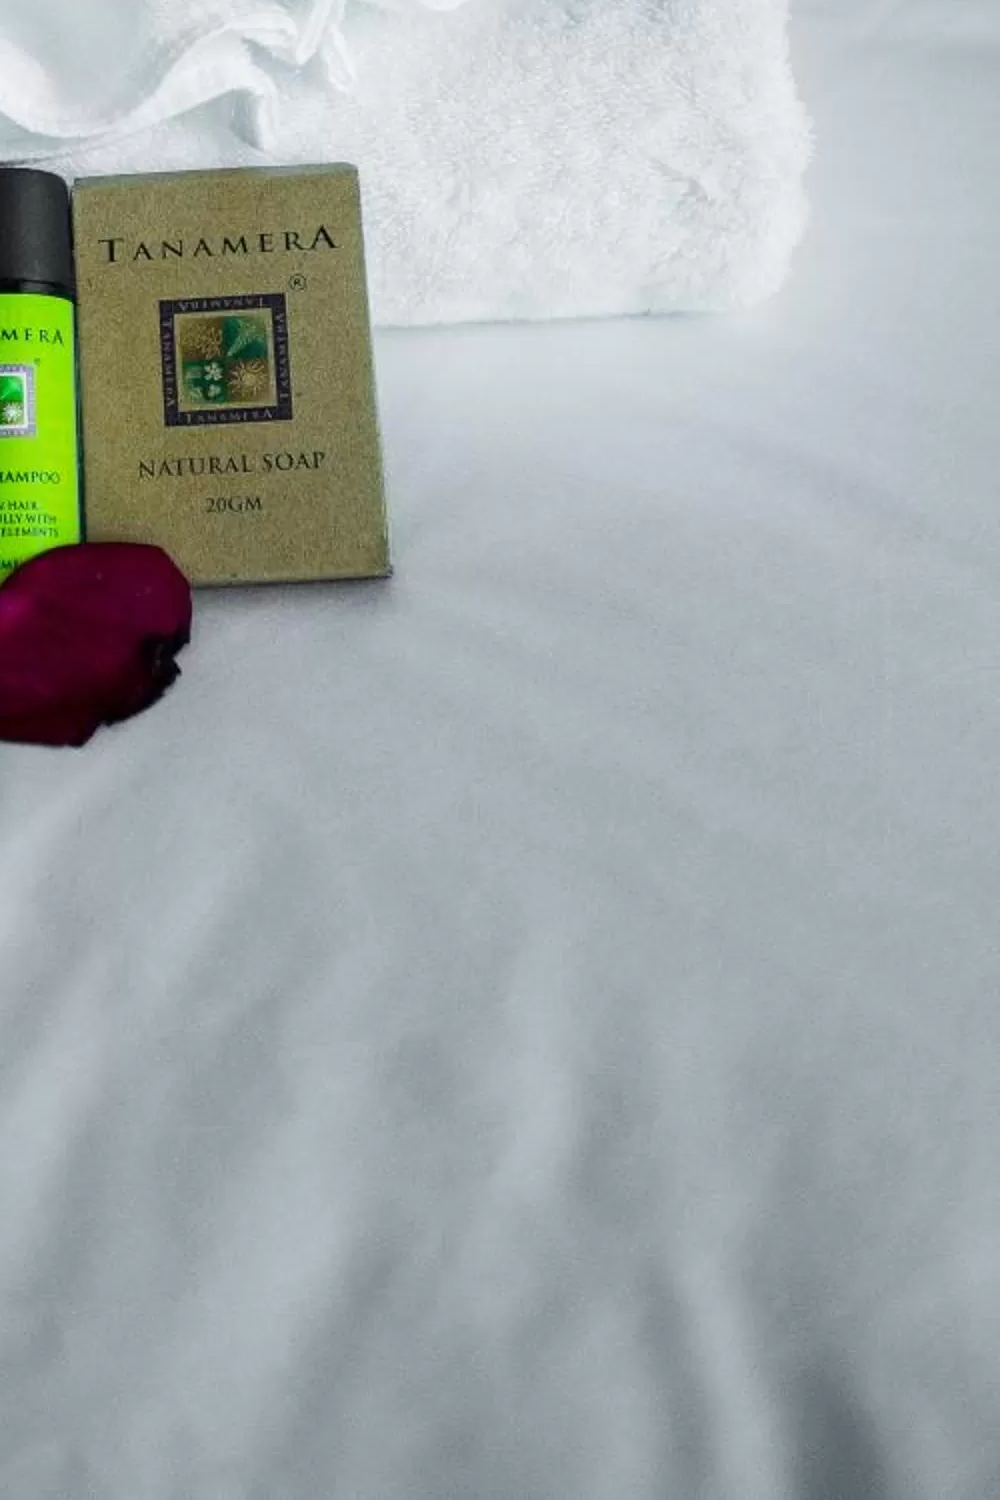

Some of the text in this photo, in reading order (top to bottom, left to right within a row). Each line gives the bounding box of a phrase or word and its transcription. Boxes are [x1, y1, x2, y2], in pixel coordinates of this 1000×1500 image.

[98, 224, 341, 263] TANAMERA
[137, 451, 326, 479] NATURAL SOAP
[206, 496, 263, 514] 20GM
